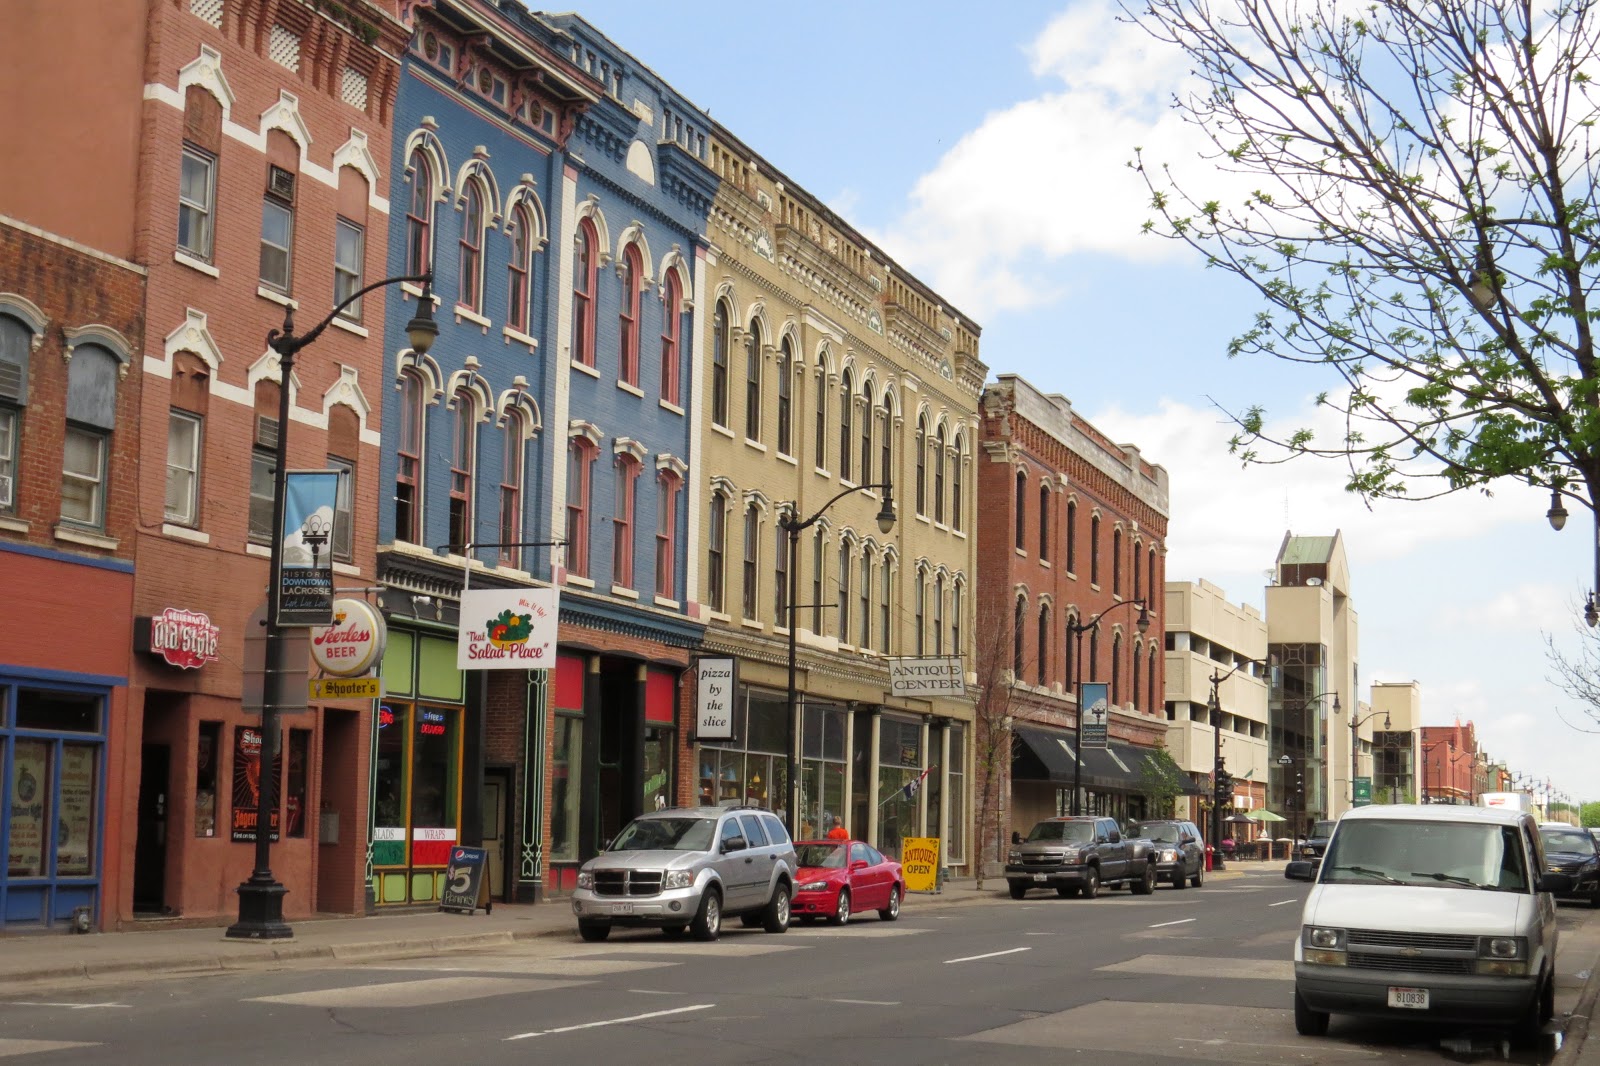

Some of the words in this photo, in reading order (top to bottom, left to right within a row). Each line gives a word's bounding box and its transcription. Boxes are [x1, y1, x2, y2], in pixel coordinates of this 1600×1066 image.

[282, 570, 331, 578] HISTORIC
[282, 577, 331, 586] DOWNTOWN
[314, 622, 370, 646] Peerless
[154, 621, 179, 650] Old
[182, 625, 217, 660] Style
[326, 646, 357, 659] BEER
[468, 643, 505, 660] Salad
[700, 667, 731, 680] pizza
[892, 665, 961, 677] ANTIQUE
[325, 681, 376, 697] Shooter's
[709, 683, 722, 697] by
[894, 679, 962, 690] CENTER
[707, 699, 723, 711] the
[702, 715, 727, 727] slice
[420, 723, 446, 735] DELIVERY
[374, 828, 395, 840] ALADS
[424, 829, 446, 840] WRAPS
[903, 847, 937, 866] ANTIQUES
[906, 864, 931, 875] OPEN
[1396, 992, 1425, 1004] 810838
